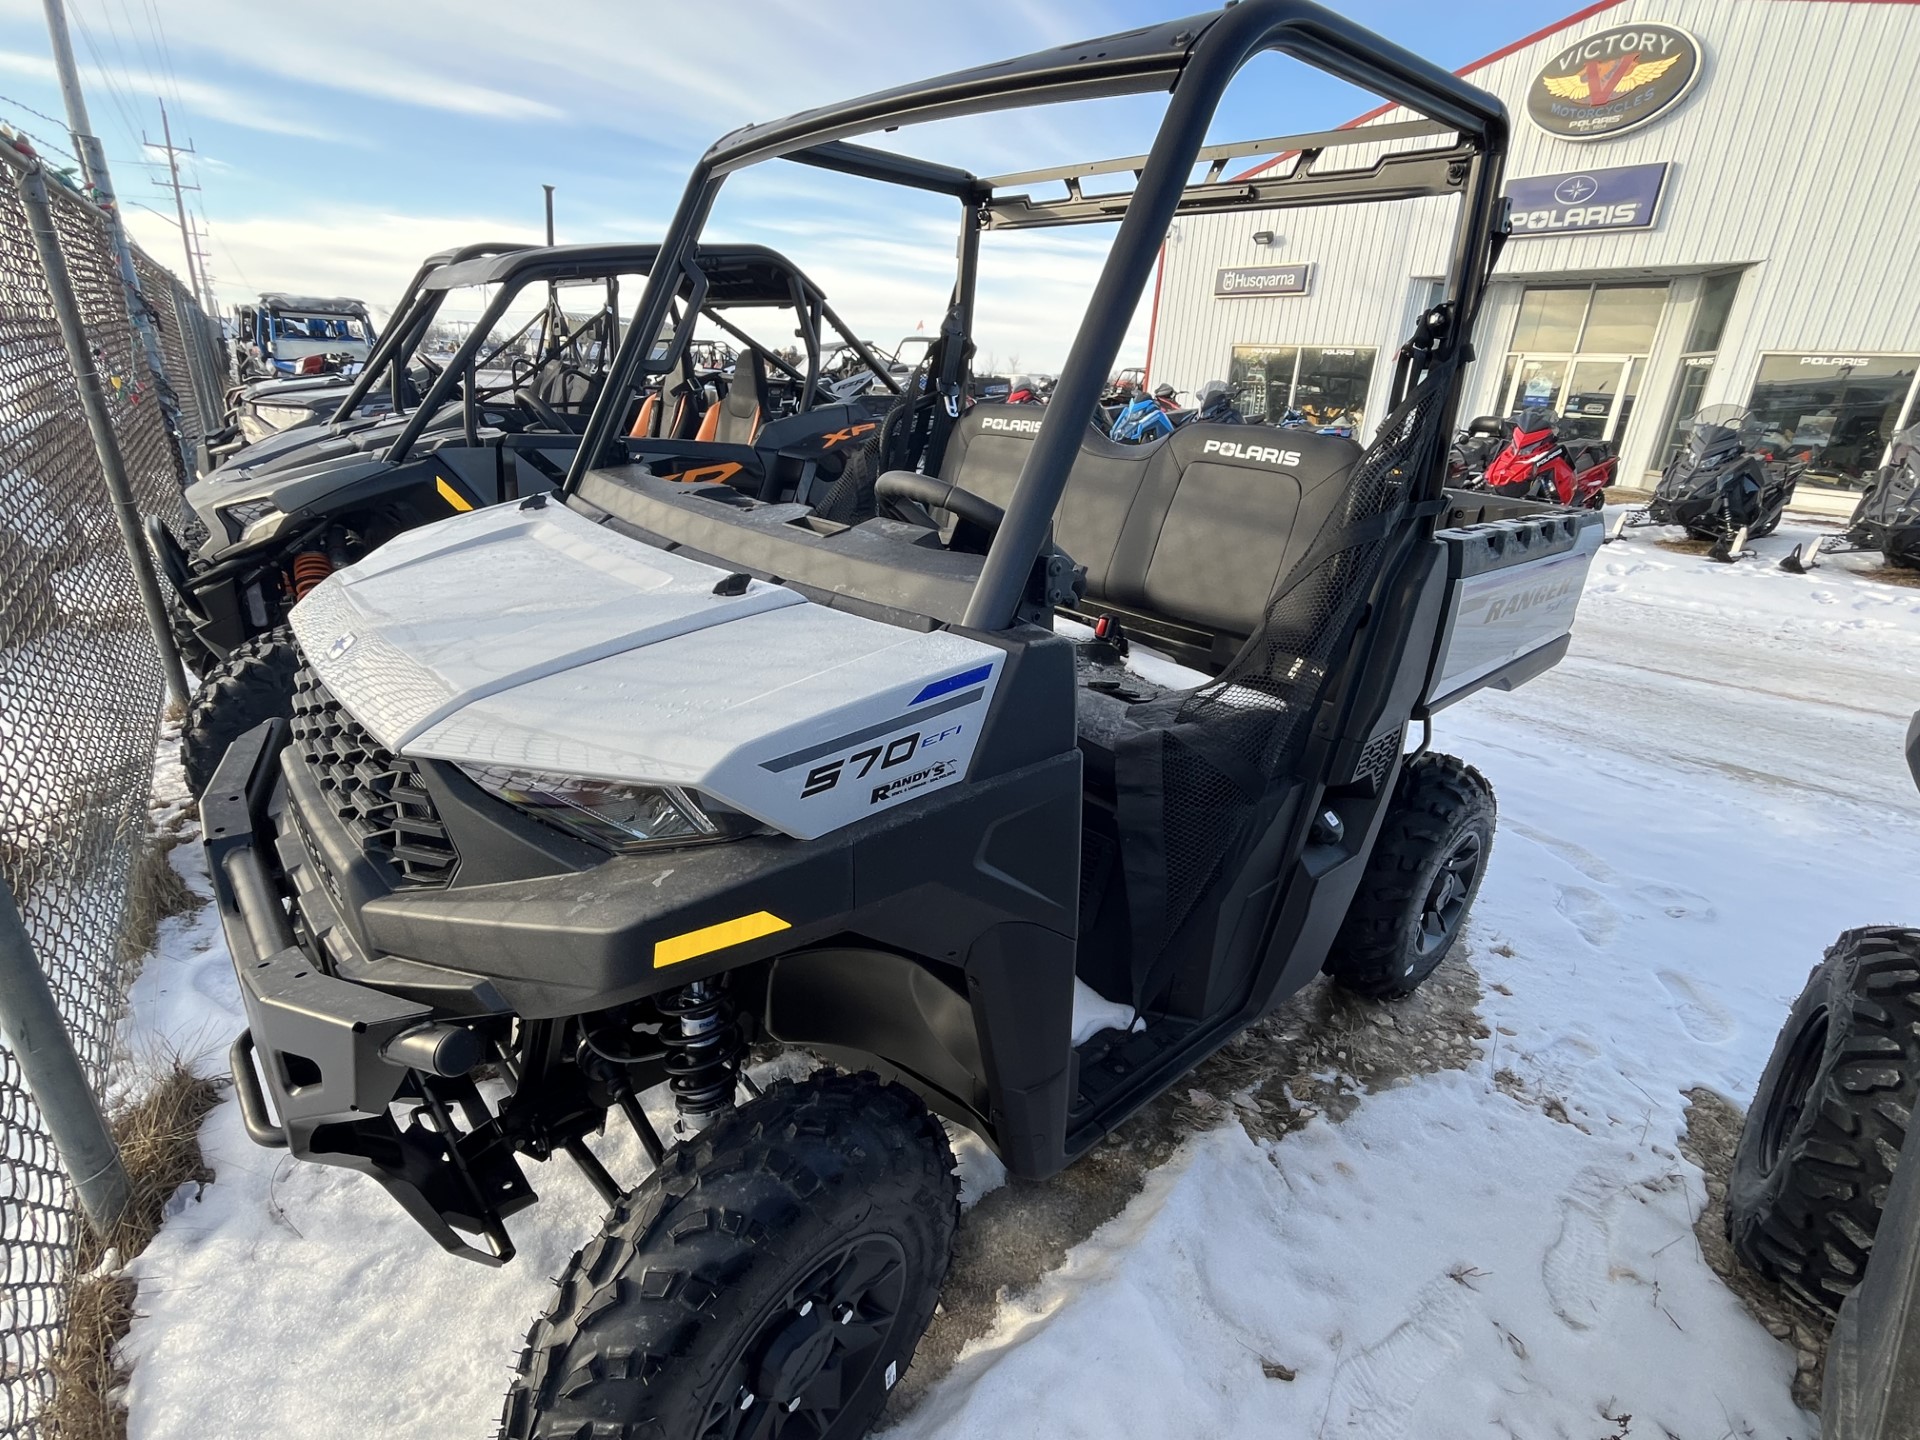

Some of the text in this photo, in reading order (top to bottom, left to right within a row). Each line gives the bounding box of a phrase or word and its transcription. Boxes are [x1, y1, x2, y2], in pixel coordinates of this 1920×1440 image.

[1559, 32, 1675, 71] VICTORY
[1551, 87, 1655, 118] MOTORCYCLES
[1569, 114, 1621, 128] POLARIS
[1509, 203, 1638, 229] POLARIS
[1235, 272, 1295, 289] Husqvarna
[1800, 357, 1869, 367] POLARIS
[822, 422, 876, 449] XP
[982, 417, 1043, 433] POLARIS
[1203, 439, 1302, 467] POLARIS
[1484, 577, 1573, 624] RANGER
[800, 732, 921, 800] 570
[921, 725, 962, 748] EFI
[869, 764, 946, 805] RANDY'S
